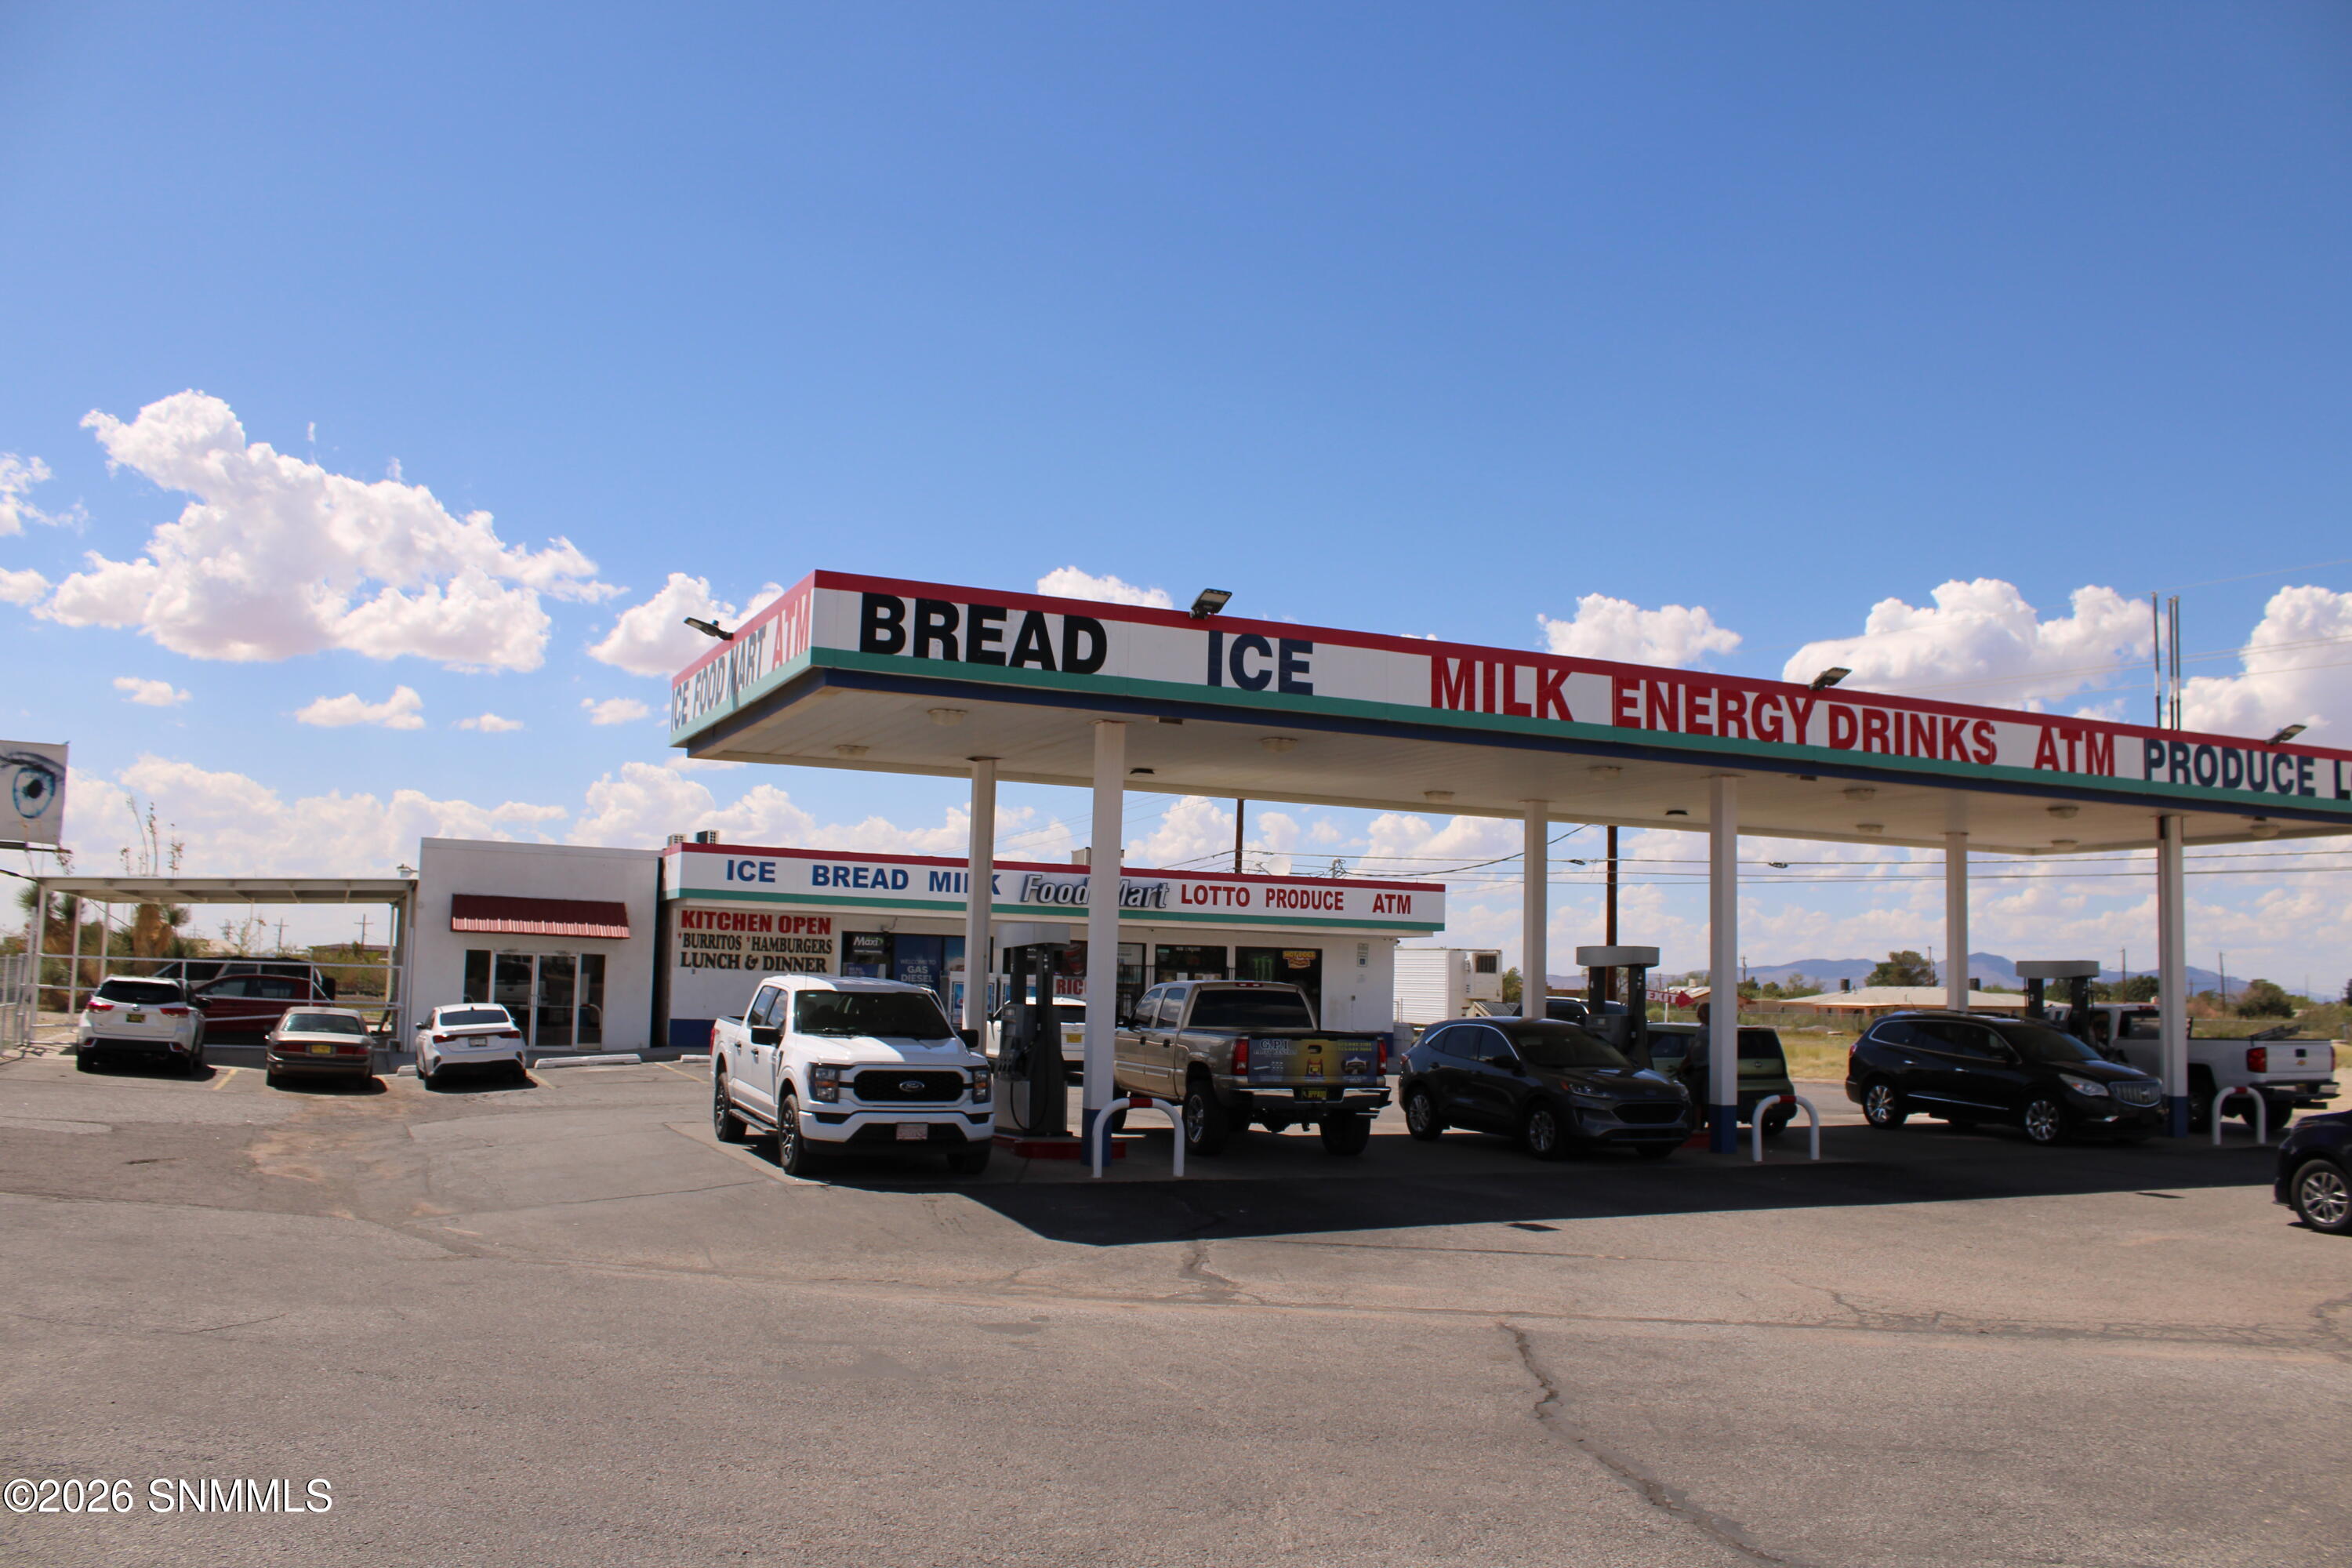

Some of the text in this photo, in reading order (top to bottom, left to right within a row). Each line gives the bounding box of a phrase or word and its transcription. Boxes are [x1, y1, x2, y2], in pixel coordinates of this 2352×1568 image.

[671, 681, 691, 733] ICE
[693, 655, 726, 720] FOOD
[771, 593, 812, 672] ATM
[860, 591, 2352, 800] BREAD ICE MILK ENERGY DRINKS ATM PRODUCE L
[727, 859, 1001, 895] ICE BREAD MIK
[1181, 884, 1411, 915] LOTTO PRODUCE ATM
[681, 910, 832, 935] KITCHEN OPEN
[682, 933, 833, 955] BURRITOS HAMBURGERS
[681, 952, 741, 970] LUNCH
[745, 954, 759, 971] &
[763, 956, 827, 973] DINNER
[906, 965, 928, 974] GAS
[900, 974, 934, 983] DIESEL
[1056, 979, 1087, 996] RIC
[1648, 991, 1678, 1004] EXIT
